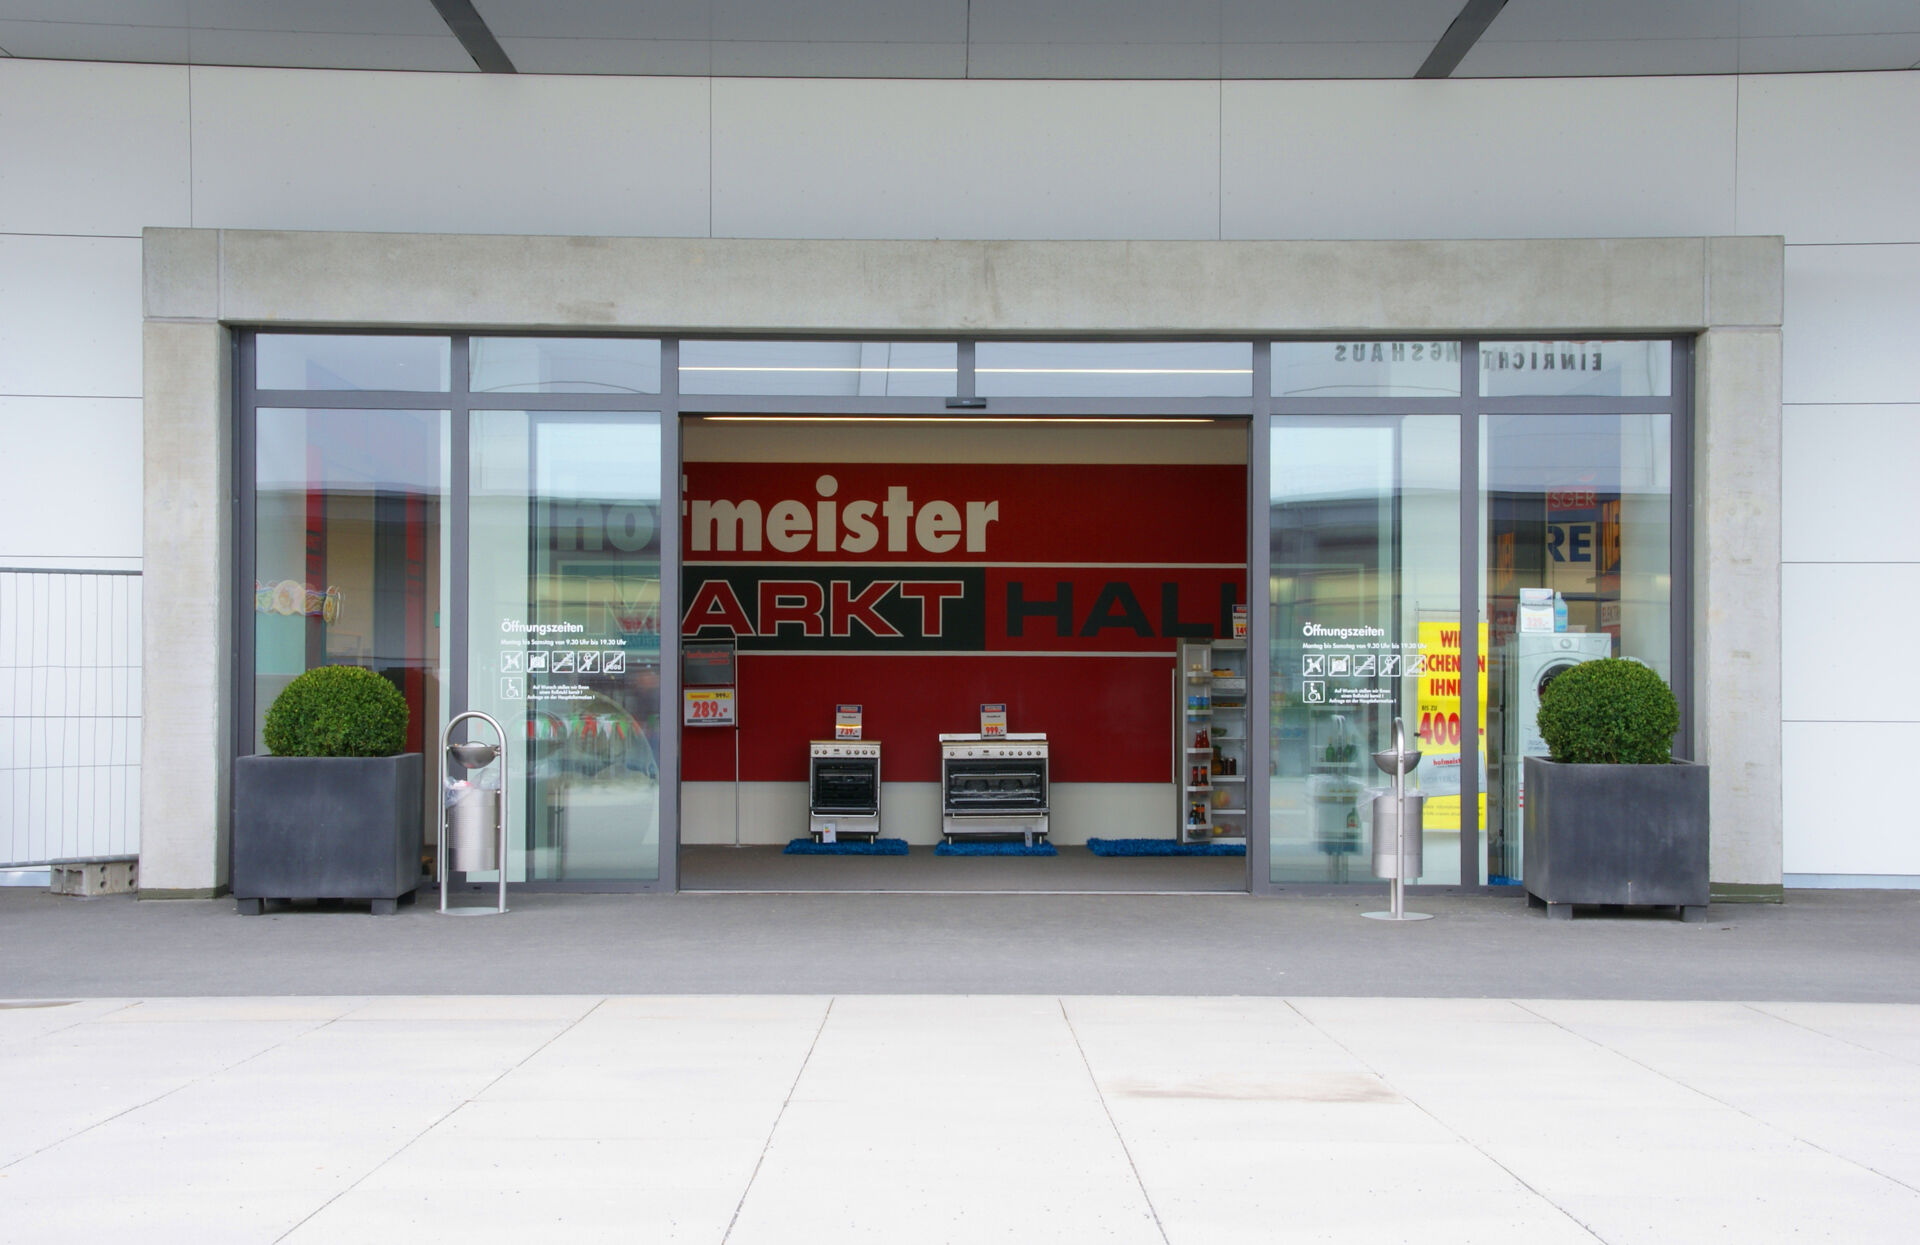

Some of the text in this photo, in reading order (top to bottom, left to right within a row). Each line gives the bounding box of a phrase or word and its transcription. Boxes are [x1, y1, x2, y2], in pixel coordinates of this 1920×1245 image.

[500, 618, 584, 636] Öffnungszeiten
[1302, 622, 1385, 639] Öffnungszeiten
[692, 701, 728, 718] 289.-
